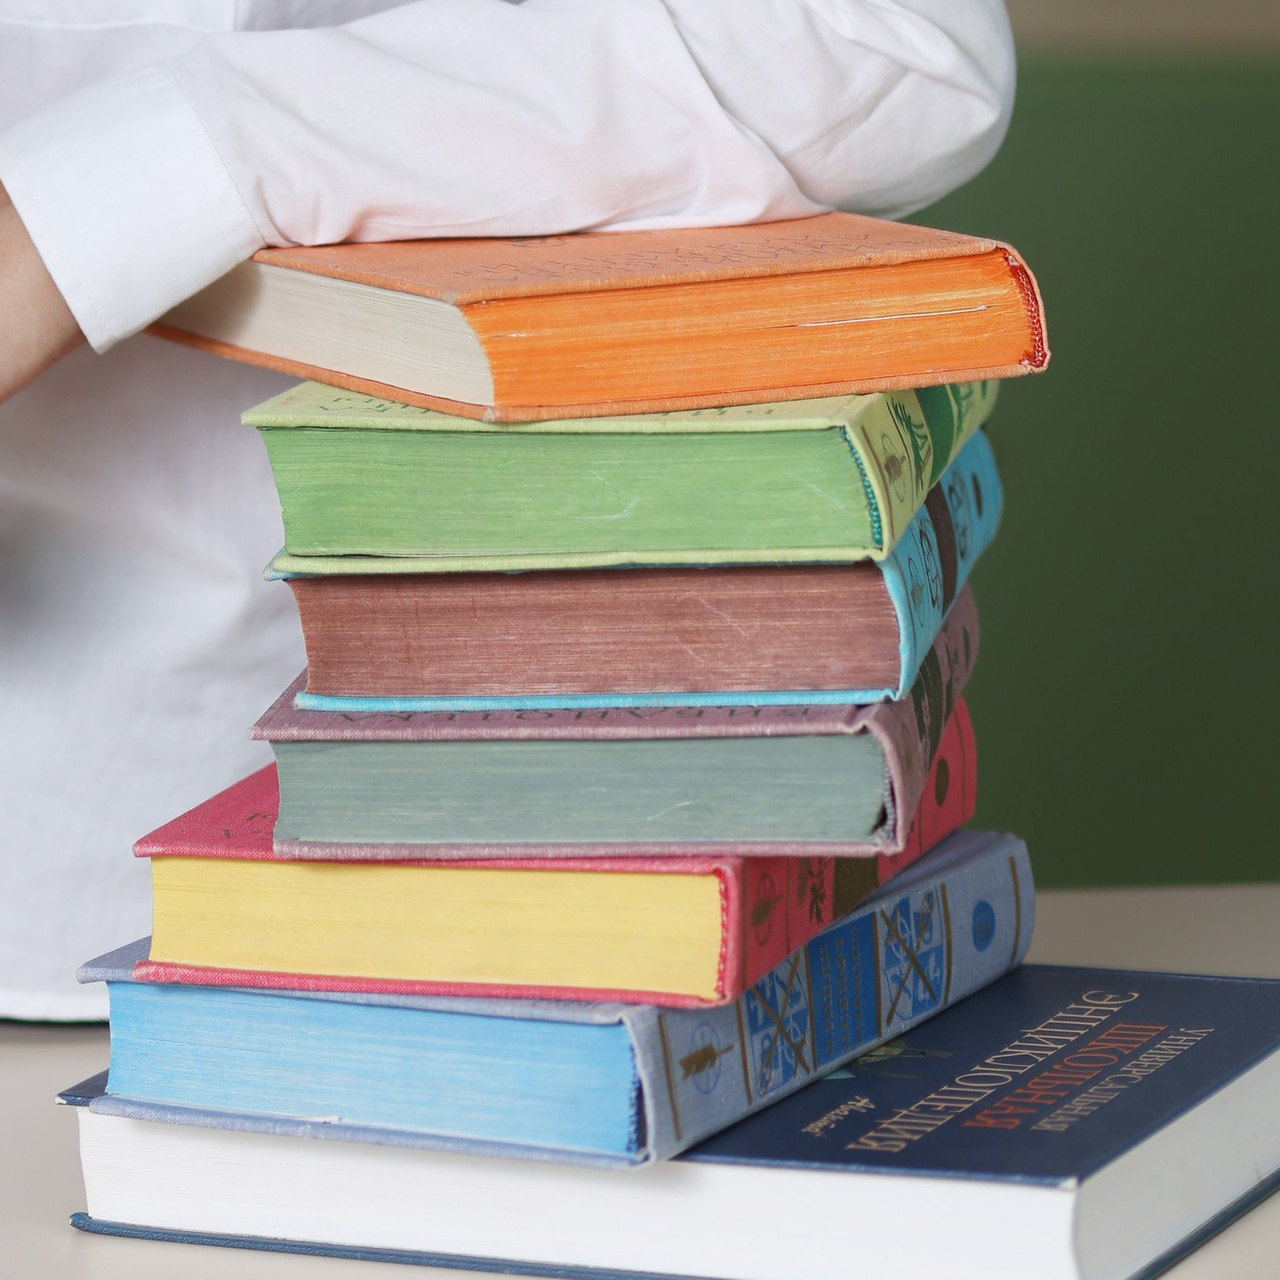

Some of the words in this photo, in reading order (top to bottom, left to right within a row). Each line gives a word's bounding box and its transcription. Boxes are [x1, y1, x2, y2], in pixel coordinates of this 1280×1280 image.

[844, 990, 1139, 1153] ЭНЦИКЛОПЕДИЯ
[962, 1021, 1169, 1130] ШКОЛЬНАЯ
[1030, 1027, 1215, 1132] УНИВЕРСАЛЬНАЯ
